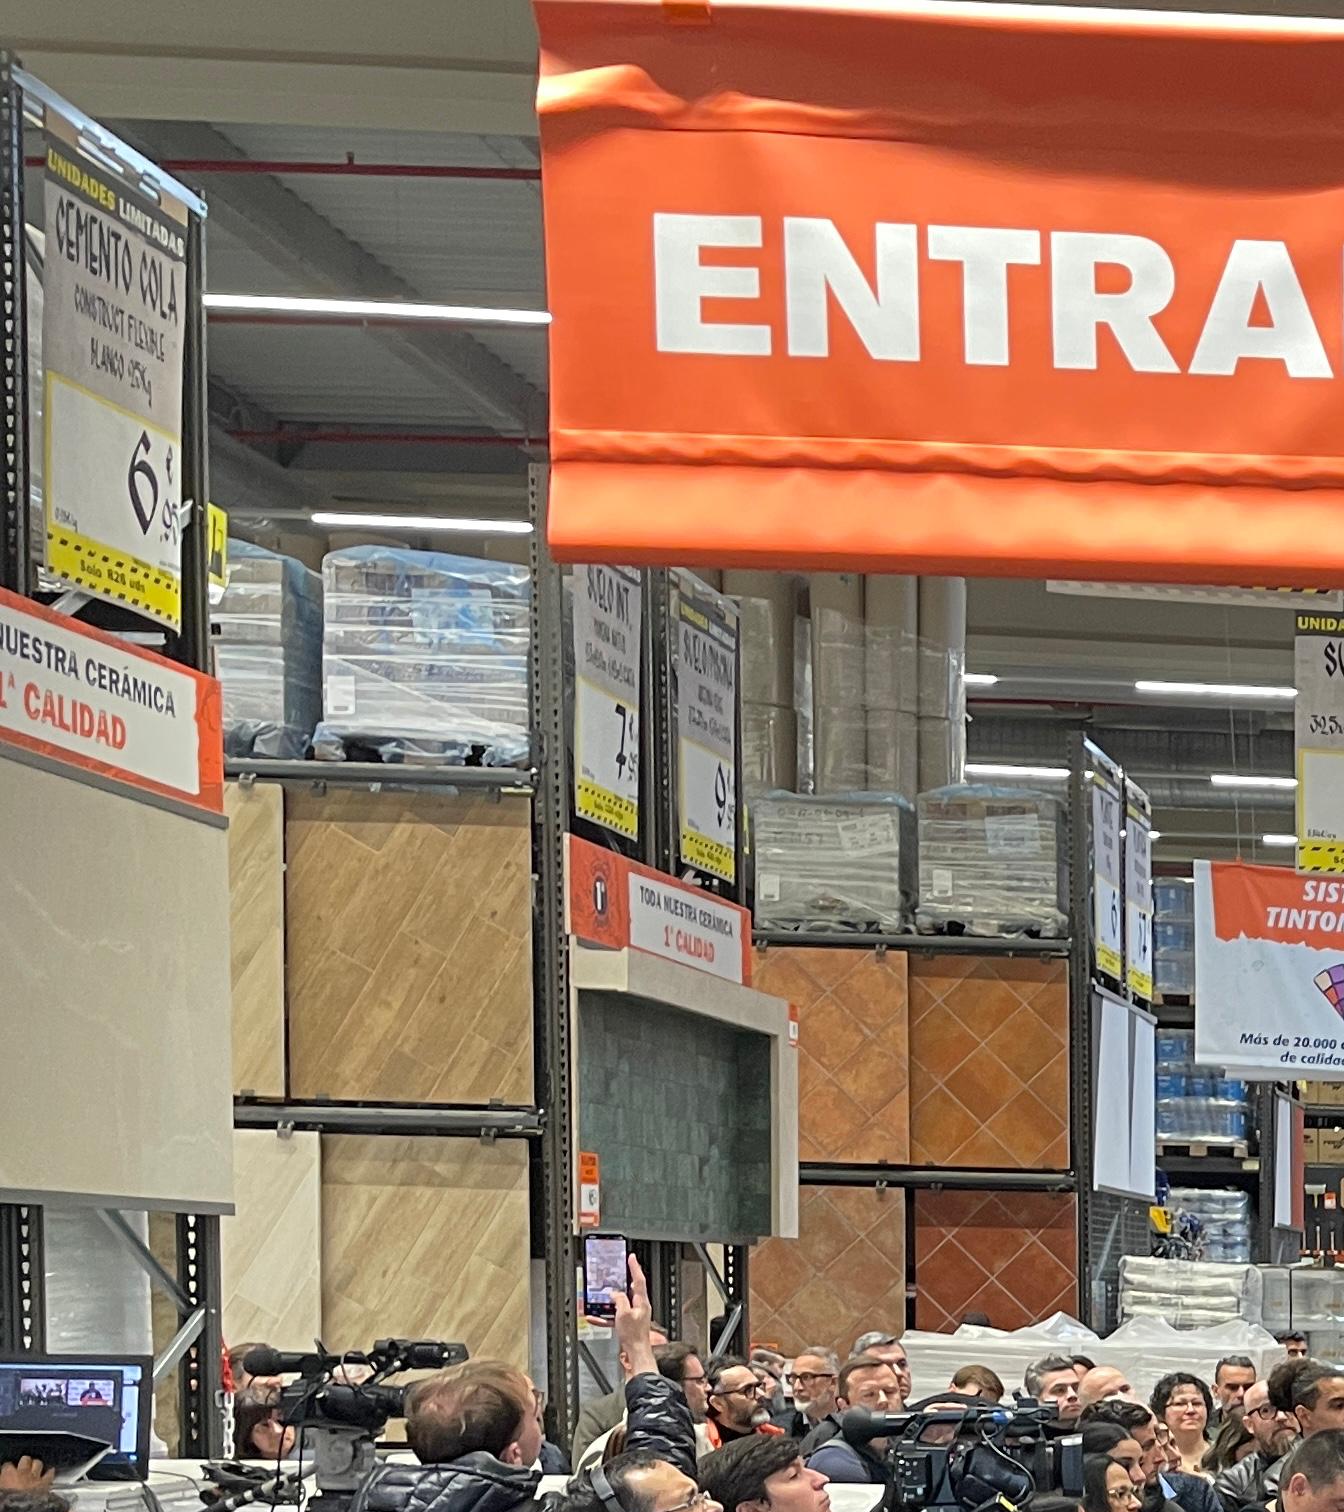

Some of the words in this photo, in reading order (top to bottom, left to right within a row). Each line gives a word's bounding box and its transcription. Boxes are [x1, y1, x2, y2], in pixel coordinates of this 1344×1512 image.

[48, 148, 115, 210] UNIDADES
[119, 198, 184, 257] LIMITADAS
[56, 196, 132, 295] CEMENTO
[140, 251, 178, 326] COLA
[85, 658, 176, 718] CERÁMICA
[24, 682, 127, 750] CALIDAD
[640, 886, 662, 909] TODA
[664, 897, 698, 923] NUESTRA
[676, 930, 715, 963] CALIDAD
[1240, 1033, 1269, 1047] Más
[1273, 1034, 1290, 1047] de
[1293, 1036, 1337, 1050] 20.000
[1280, 1052, 1297, 1064] de
